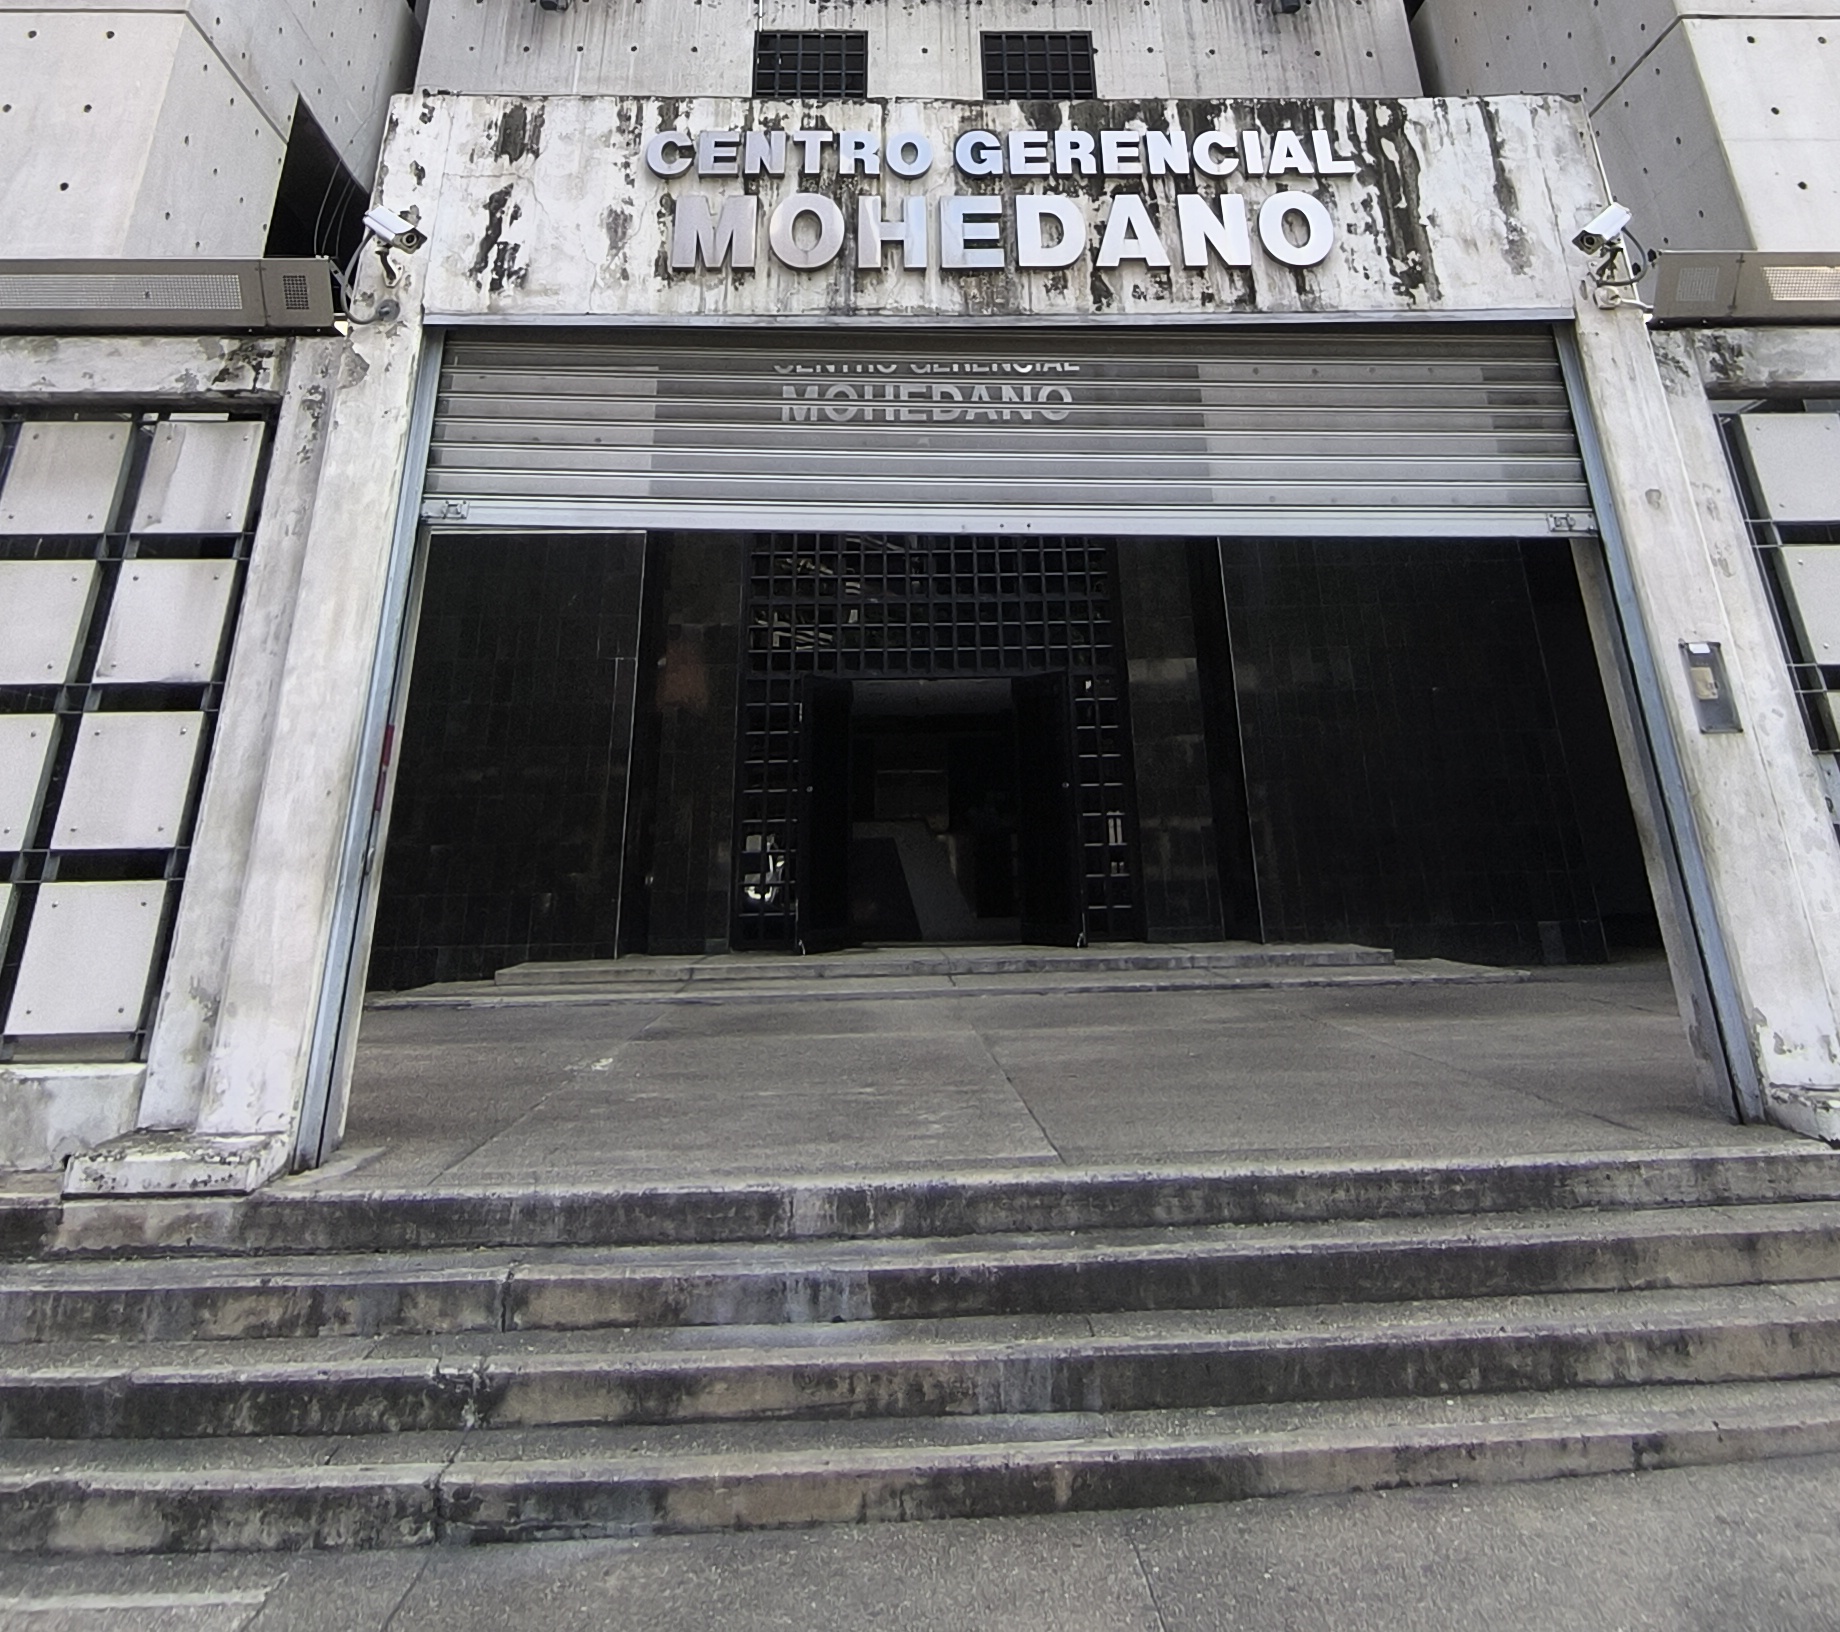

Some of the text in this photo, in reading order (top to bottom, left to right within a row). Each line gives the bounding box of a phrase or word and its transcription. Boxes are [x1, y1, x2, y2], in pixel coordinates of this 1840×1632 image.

[645, 129, 1358, 179] CENTRO GERENCIAL
[671, 190, 1335, 272] MOHEDANO
[780, 383, 1074, 422] MOHEDANO
